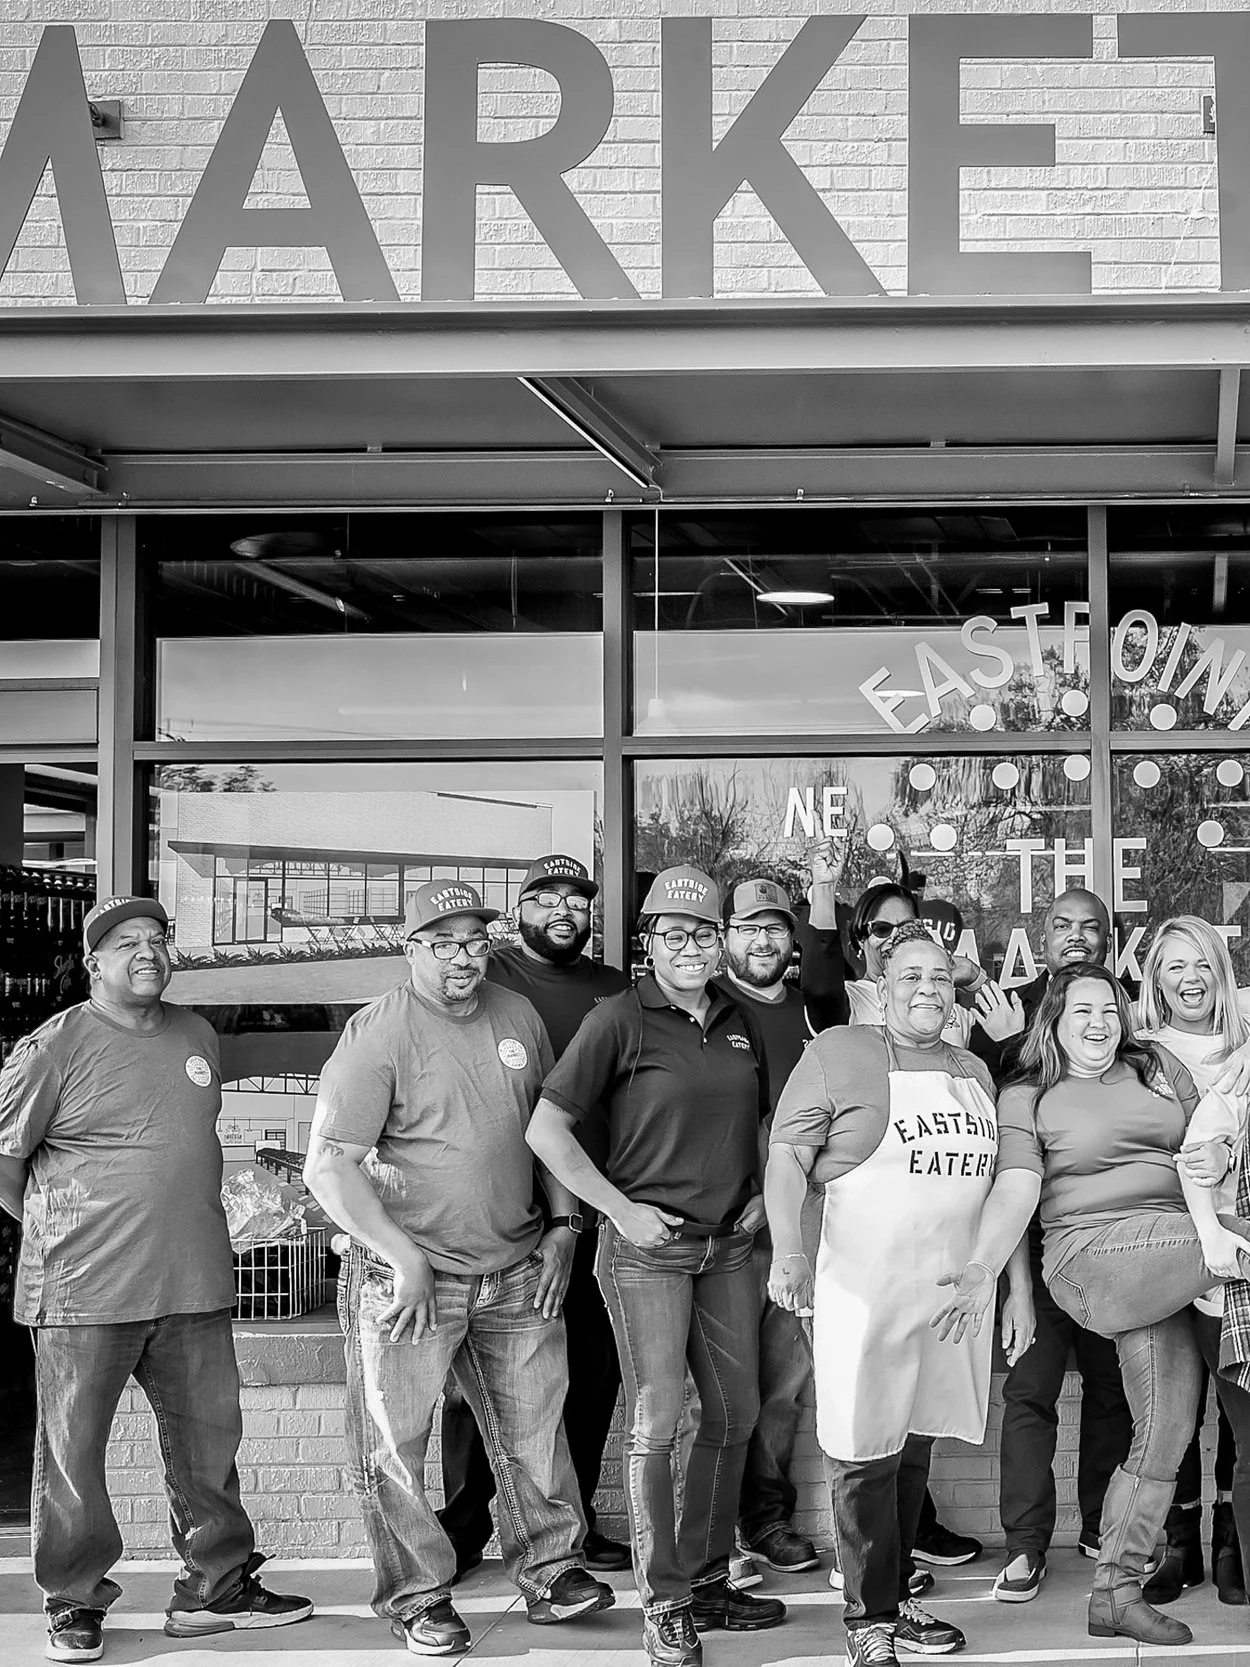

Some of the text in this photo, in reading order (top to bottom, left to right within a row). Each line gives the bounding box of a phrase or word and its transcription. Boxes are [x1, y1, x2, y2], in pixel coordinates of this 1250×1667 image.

[783, 787, 848, 838] NE
[548, 867, 580, 878] EATERY
[1006, 837, 1147, 913] THE
[430, 887, 473, 905] EASTSIDE
[664, 878, 708, 896] EASTSIDE
[438, 898, 473, 912] EATERY
[667, 890, 704, 903] EATERY
